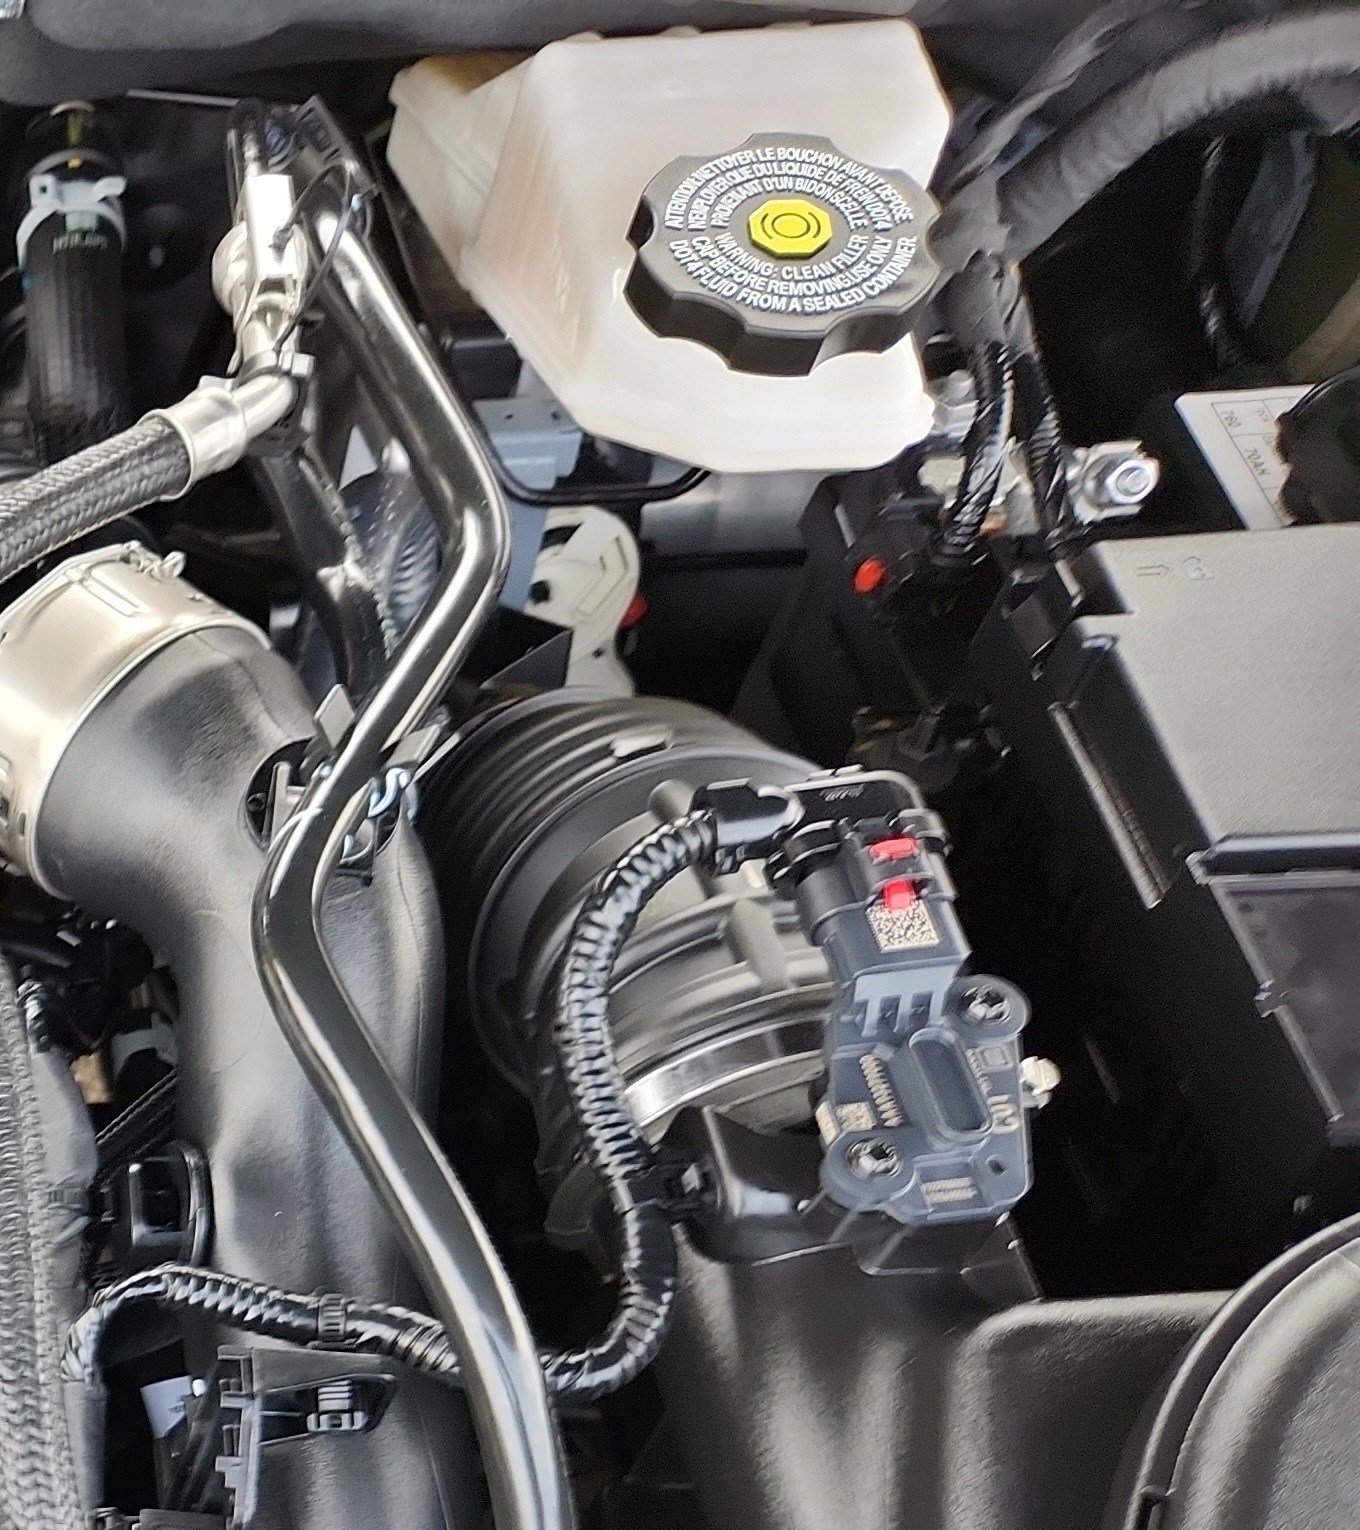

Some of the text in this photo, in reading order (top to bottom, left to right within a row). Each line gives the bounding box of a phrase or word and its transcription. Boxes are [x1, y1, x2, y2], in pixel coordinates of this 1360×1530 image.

[752, 162, 773, 177] DU
[773, 161, 827, 180] LIQUIDE
[823, 170, 847, 186] DE
[756, 147, 776, 161] LE
[777, 147, 844, 169] BOUCHON
[838, 161, 885, 188] AVANT
[795, 177, 836, 200] BIDON
[691, 236, 720, 259] CAP
[709, 256, 768, 291] BEFORE
[845, 260, 879, 284] USE
[866, 235, 893, 265] ONLY
[781, 259, 837, 280] CLEAN
[830, 235, 870, 270] FILLER
[691, 266, 739, 297] FLUID
[735, 286, 787, 311] FROM
[787, 297, 801, 311] A
[803, 286, 867, 312] SEALED
